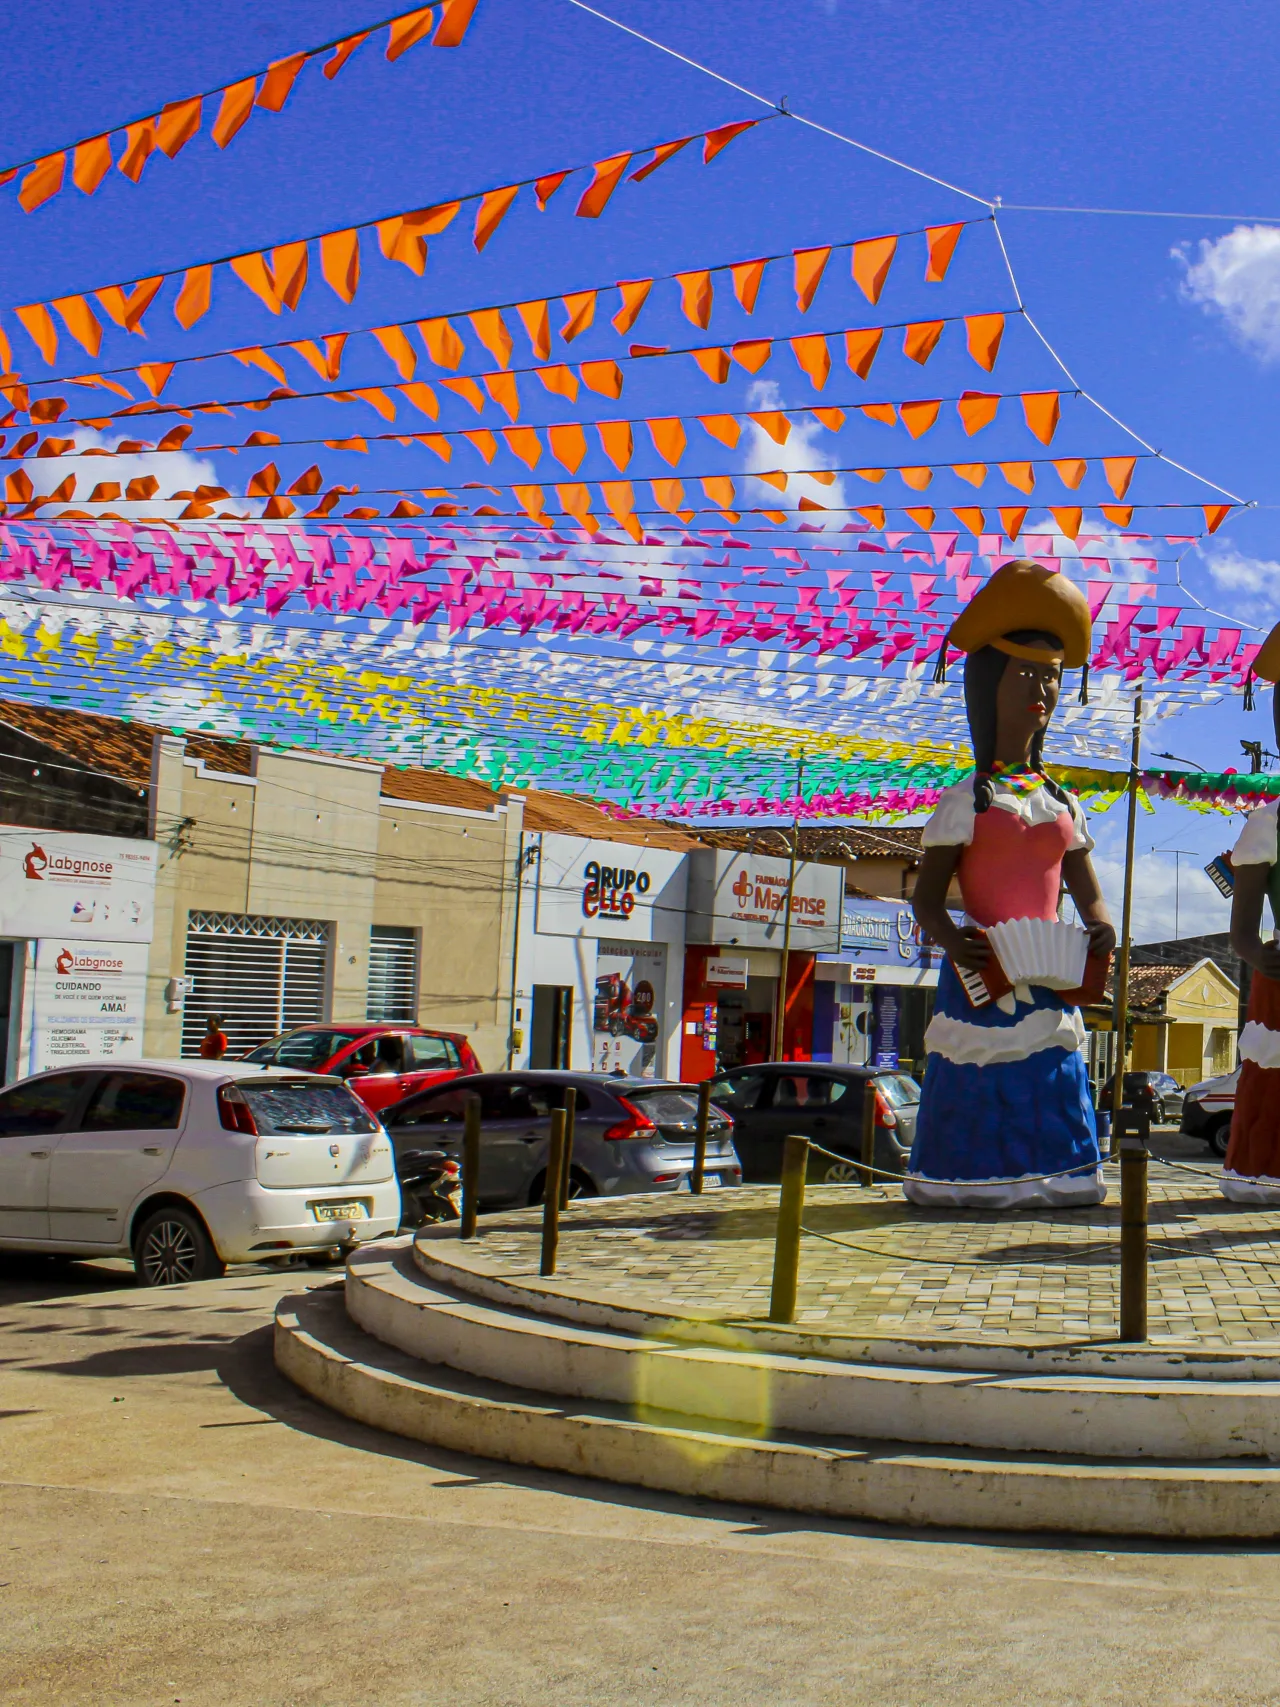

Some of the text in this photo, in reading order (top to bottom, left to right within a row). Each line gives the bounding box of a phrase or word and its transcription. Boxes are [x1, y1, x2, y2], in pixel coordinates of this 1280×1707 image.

[48, 855, 113, 873] Labgnose
[754, 886, 826, 915] Marense
[75, 957, 123, 969] Labgnose
[55, 982, 102, 991] CUIDANDO
[100, 1003, 127, 1012] AMA!
